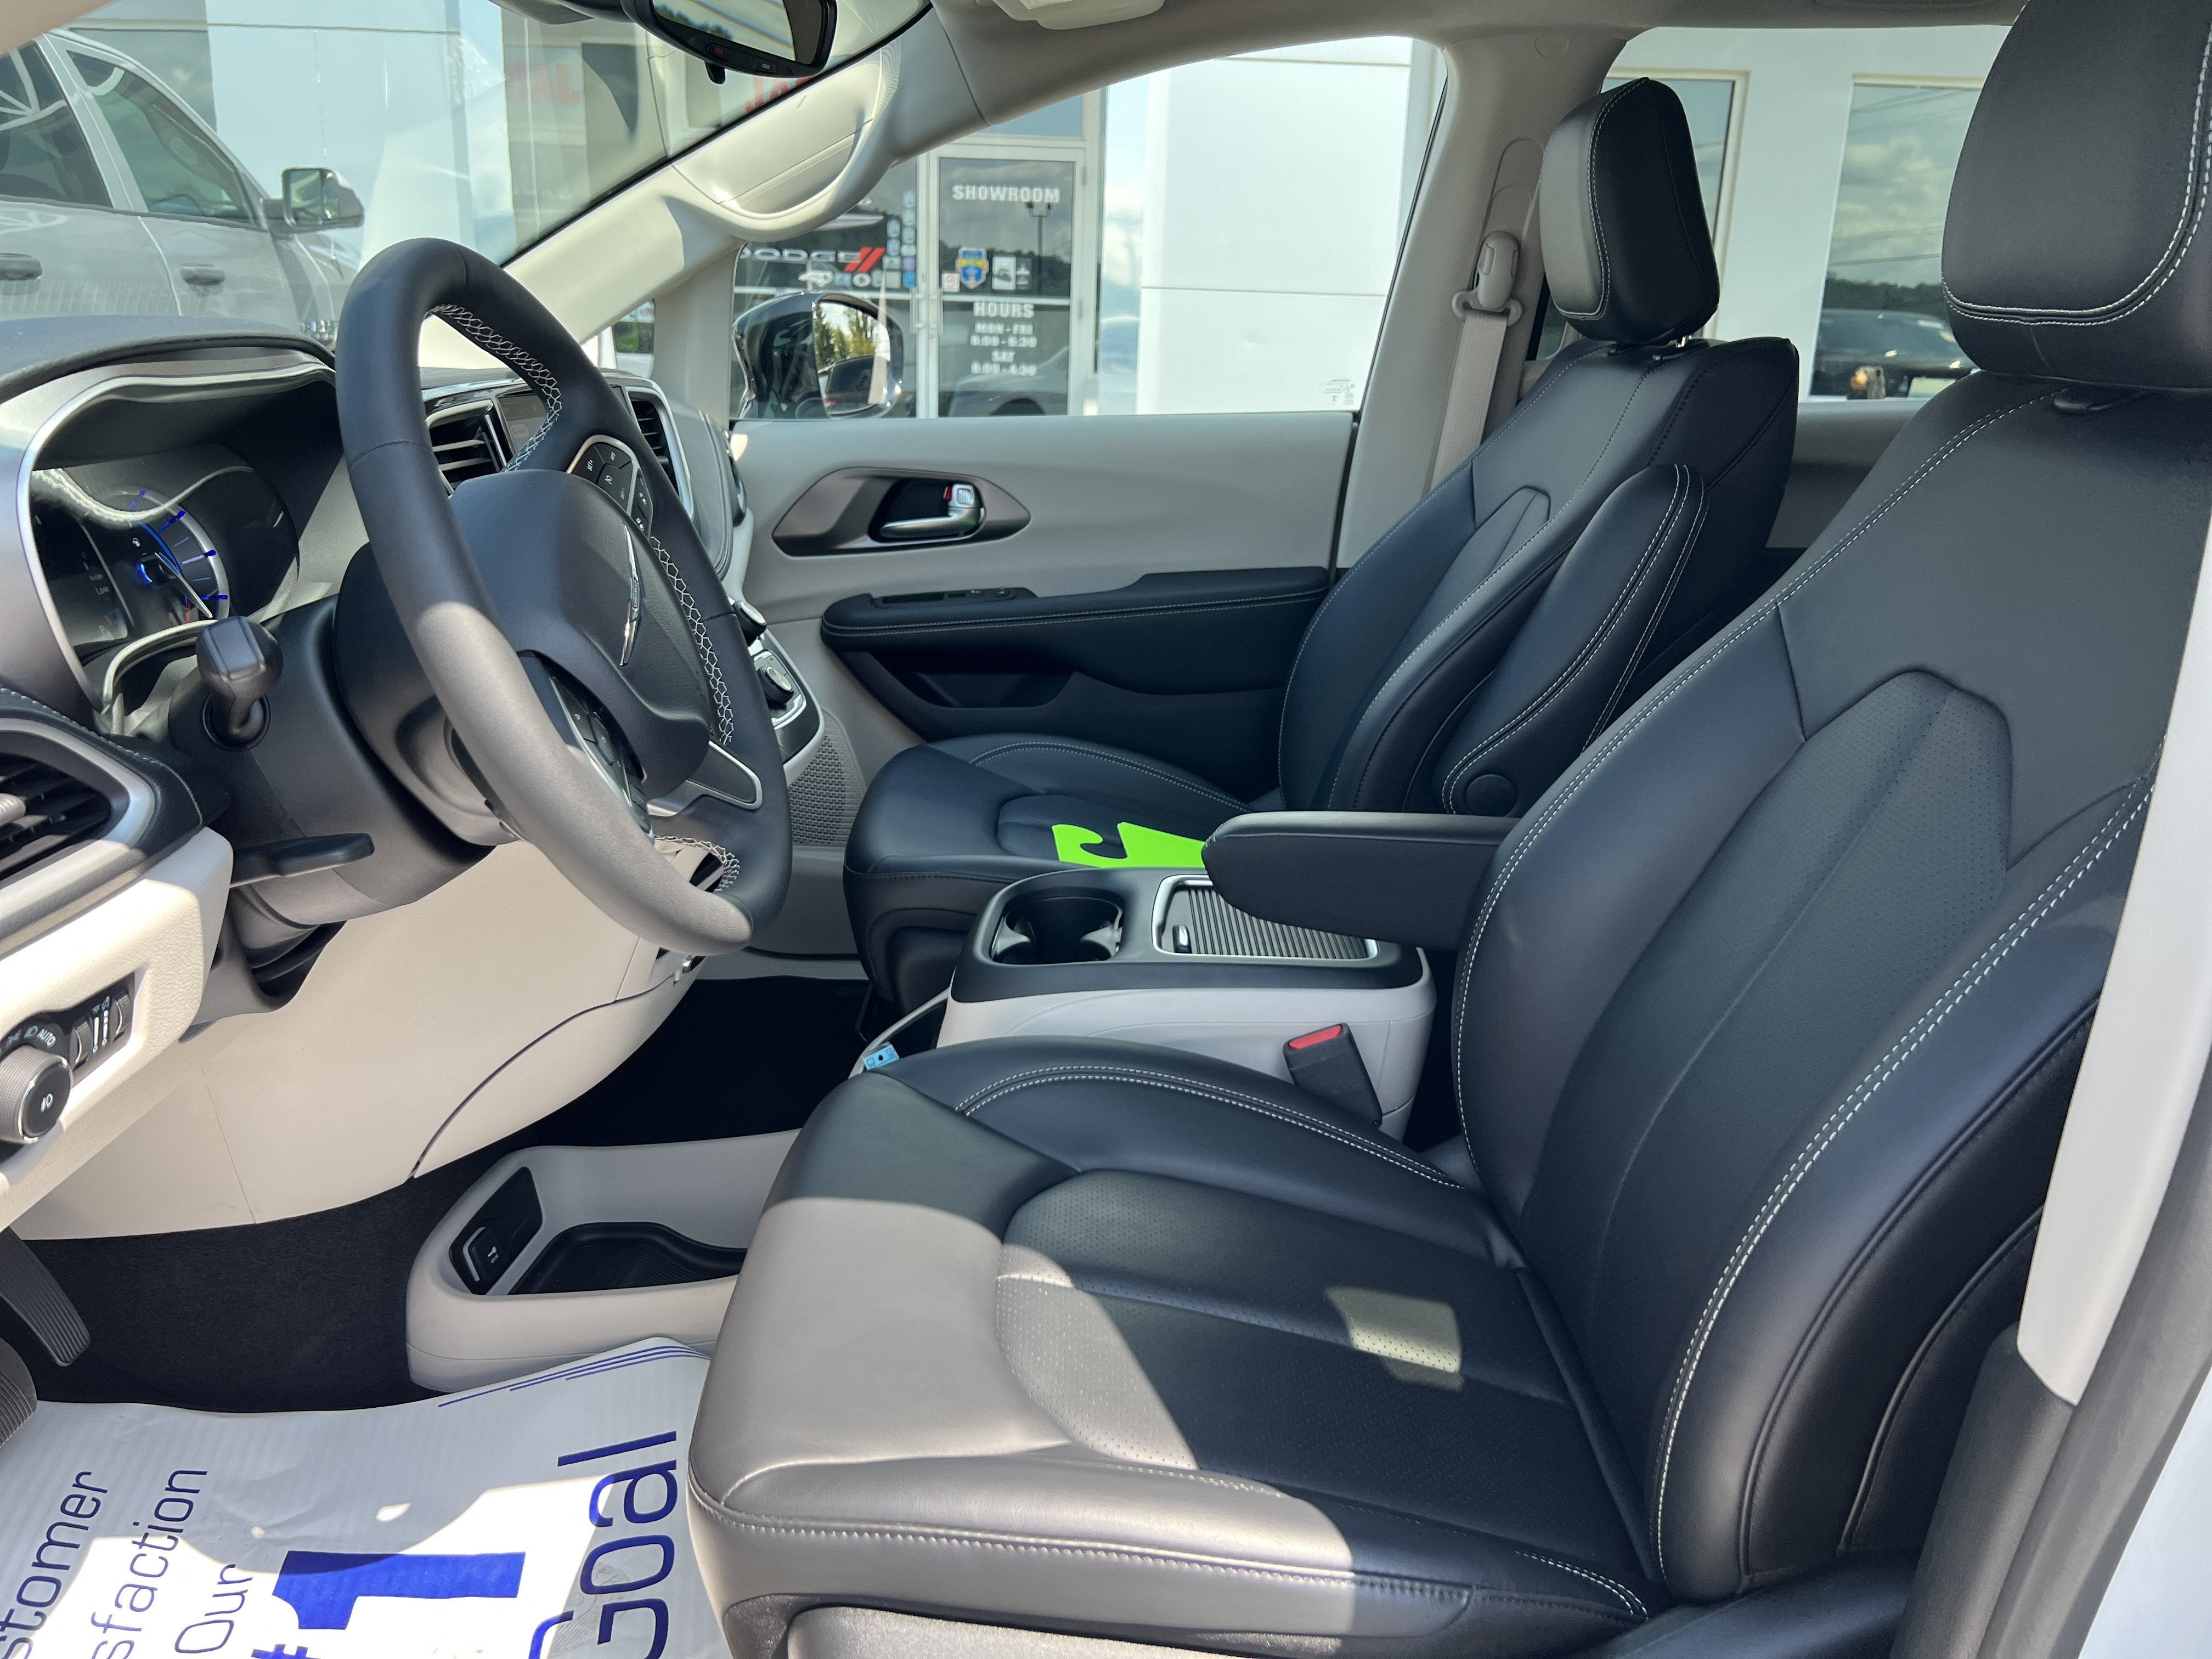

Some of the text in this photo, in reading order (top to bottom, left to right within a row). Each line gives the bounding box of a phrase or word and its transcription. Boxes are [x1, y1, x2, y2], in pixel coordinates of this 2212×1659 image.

[952, 184, 1060, 203] SHOWROOM
[973, 302, 1034, 318] HOURS
[37, 1028, 57, 1046] AUTO
[529, 1431, 677, 1659] Goal
[174, 1563, 253, 1654] Our
